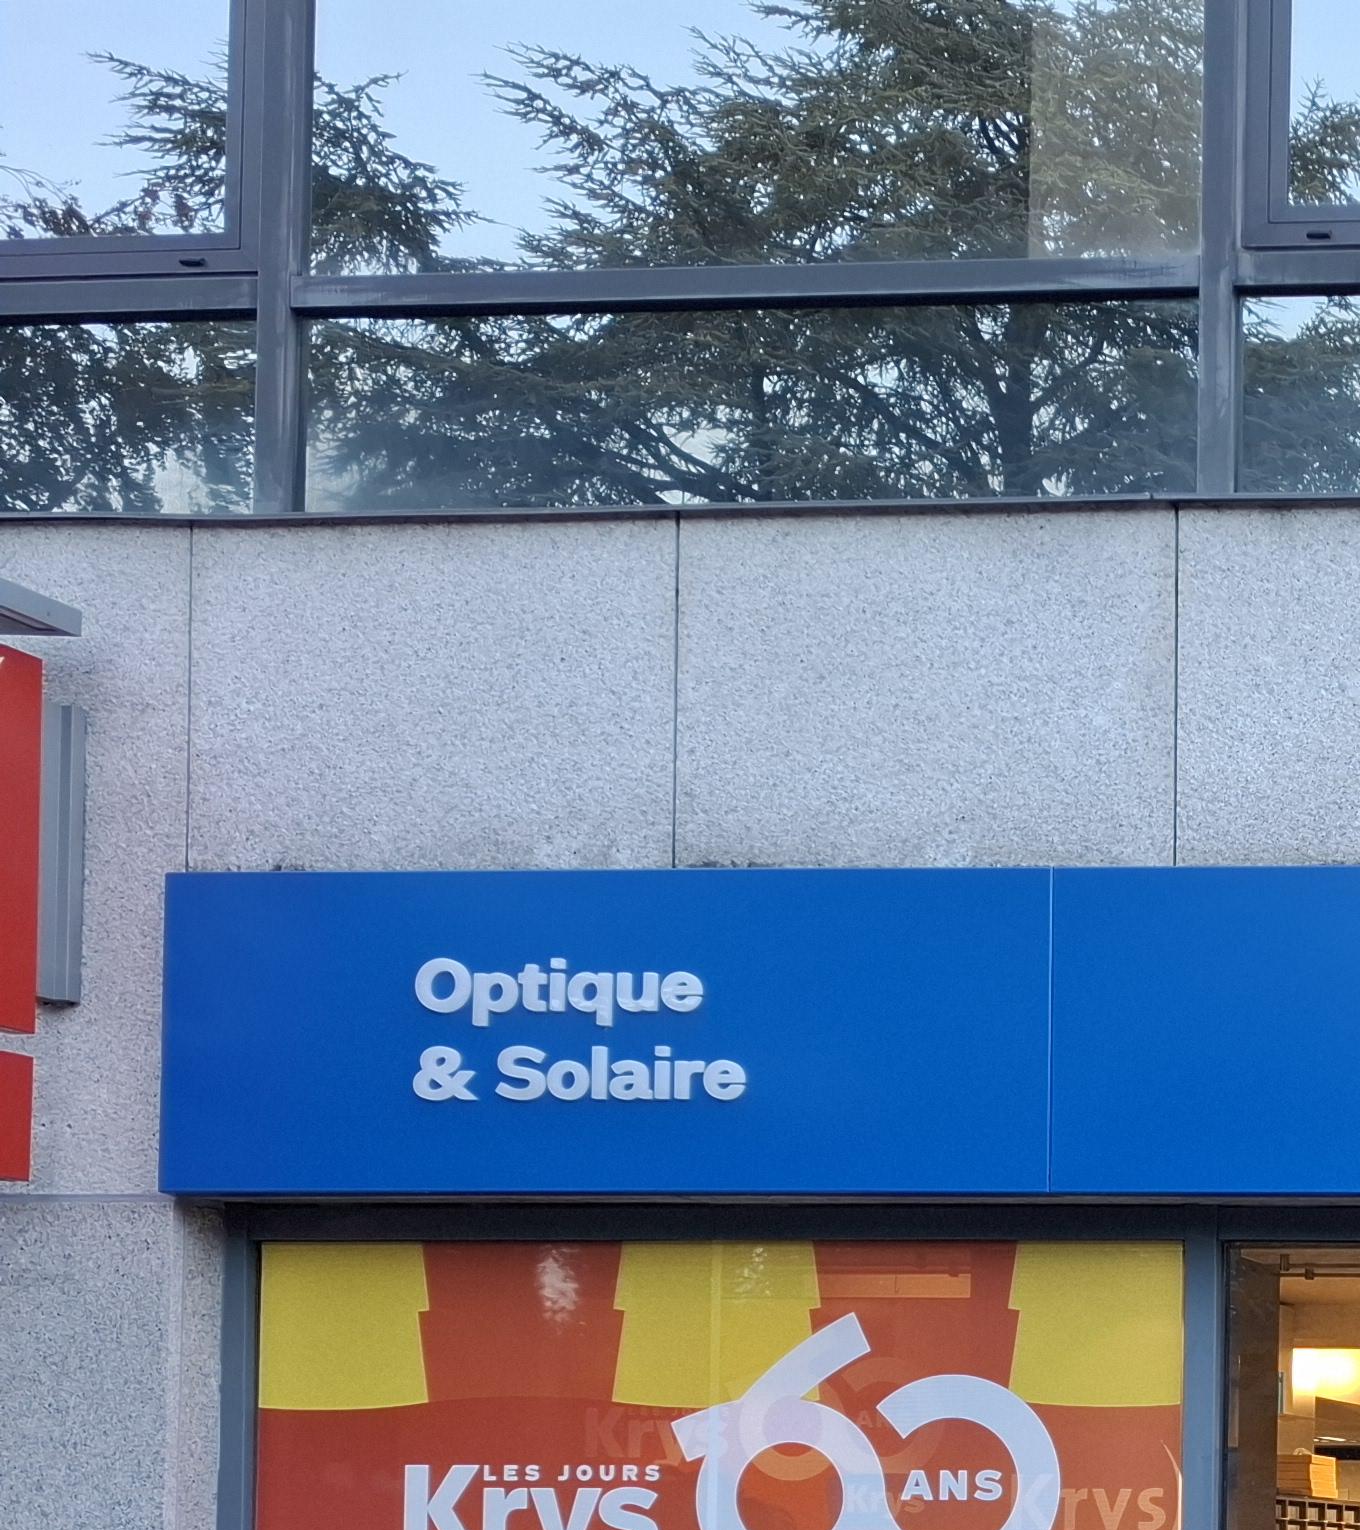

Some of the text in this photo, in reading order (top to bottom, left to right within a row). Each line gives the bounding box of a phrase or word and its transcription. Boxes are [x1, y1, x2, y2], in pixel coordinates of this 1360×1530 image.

[414, 957, 704, 1027] Optique
[412, 1045, 747, 1101] & Solaire
[482, 1464, 661, 1482] LES JOURS
[900, 1468, 1004, 1502] ANS
